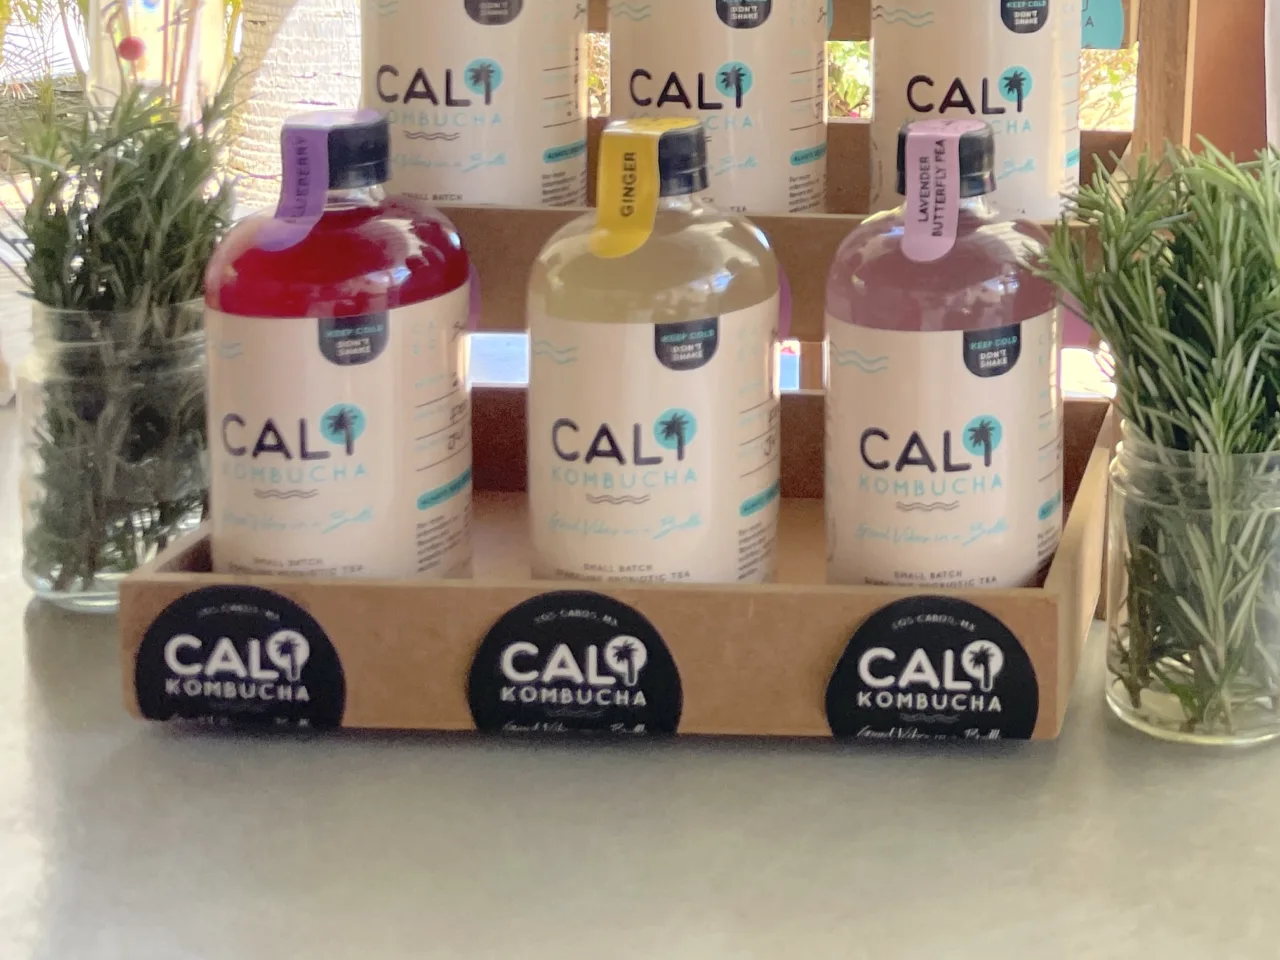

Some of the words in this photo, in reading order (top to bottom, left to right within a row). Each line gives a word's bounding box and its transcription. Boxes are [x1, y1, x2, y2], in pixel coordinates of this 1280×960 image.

[388, 110, 503, 127] OMBUCHA
[934, 139, 947, 162] PEA
[621, 152, 637, 217] GINGER
[918, 156, 930, 222] LAVENDER
[931, 167, 947, 237] BUTTERFLY
[970, 341, 992, 350] KEEP
[994, 336, 1017, 346] COLD
[980, 349, 1006, 359] DON'T
[980, 357, 1008, 368] SHAKE
[551, 467, 698, 489] KOMBUCHA
[859, 472, 1003, 496] KOMBUCHA
[619, 564, 653, 572] BATCH
[671, 570, 691, 579] TEA
[930, 570, 963, 580] BATCH
[979, 576, 997, 585] TEA
[164, 678, 310, 702] KOMBUCHA
[502, 686, 647, 706] KOMBUCHA
[857, 690, 1001, 712] KOMBUCHA
